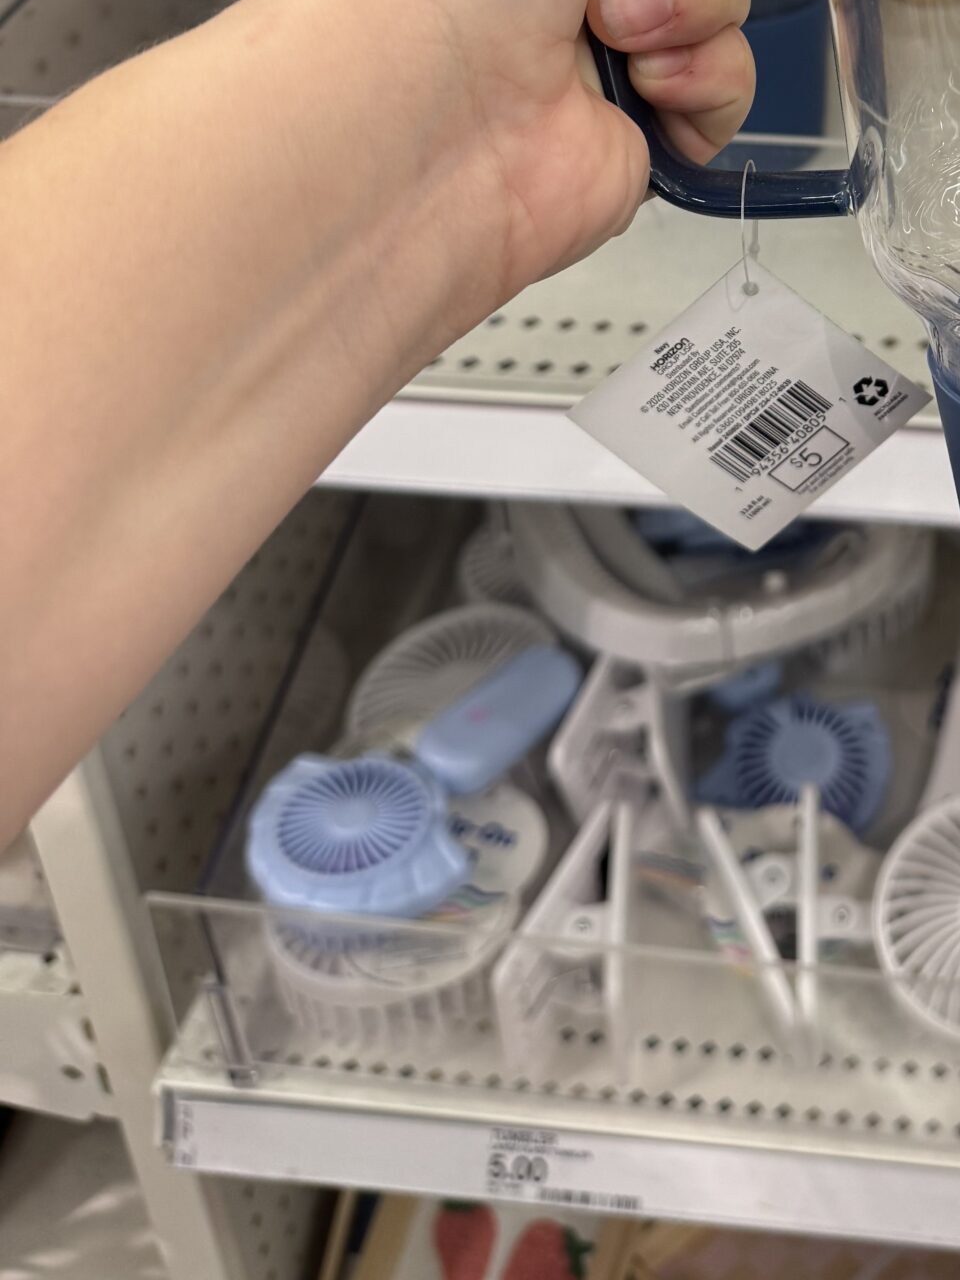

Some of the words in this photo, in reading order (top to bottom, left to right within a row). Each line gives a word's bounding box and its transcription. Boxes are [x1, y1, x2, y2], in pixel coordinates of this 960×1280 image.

[646, 392, 665, 408] 2026
[662, 369, 692, 394] HORIZON
[689, 350, 714, 371] GROUP
[710, 337, 729, 353] USA,
[725, 326, 741, 339] INC.
[655, 342, 669, 354] Navy
[657, 354, 682, 375] GROUP
[680, 342, 695, 355] USA
[666, 356, 693, 378] Distributed
[691, 350, 700, 358] By
[655, 401, 670, 413] 430
[667, 375, 700, 403] MOUNTAIN
[709, 349, 729, 366] SUITE
[726, 339, 741, 351] 205
[667, 403, 683, 416] NEW
[718, 363, 729, 372] NJ
[725, 348, 746, 365] 07974
[734, 383, 759, 404] ORIGIN:
[756, 366, 778, 384] CHINA
[751, 444, 790, 477] 94356
[788, 412, 827, 445] 40805
[489, 1153, 549, 1183] 5.00
